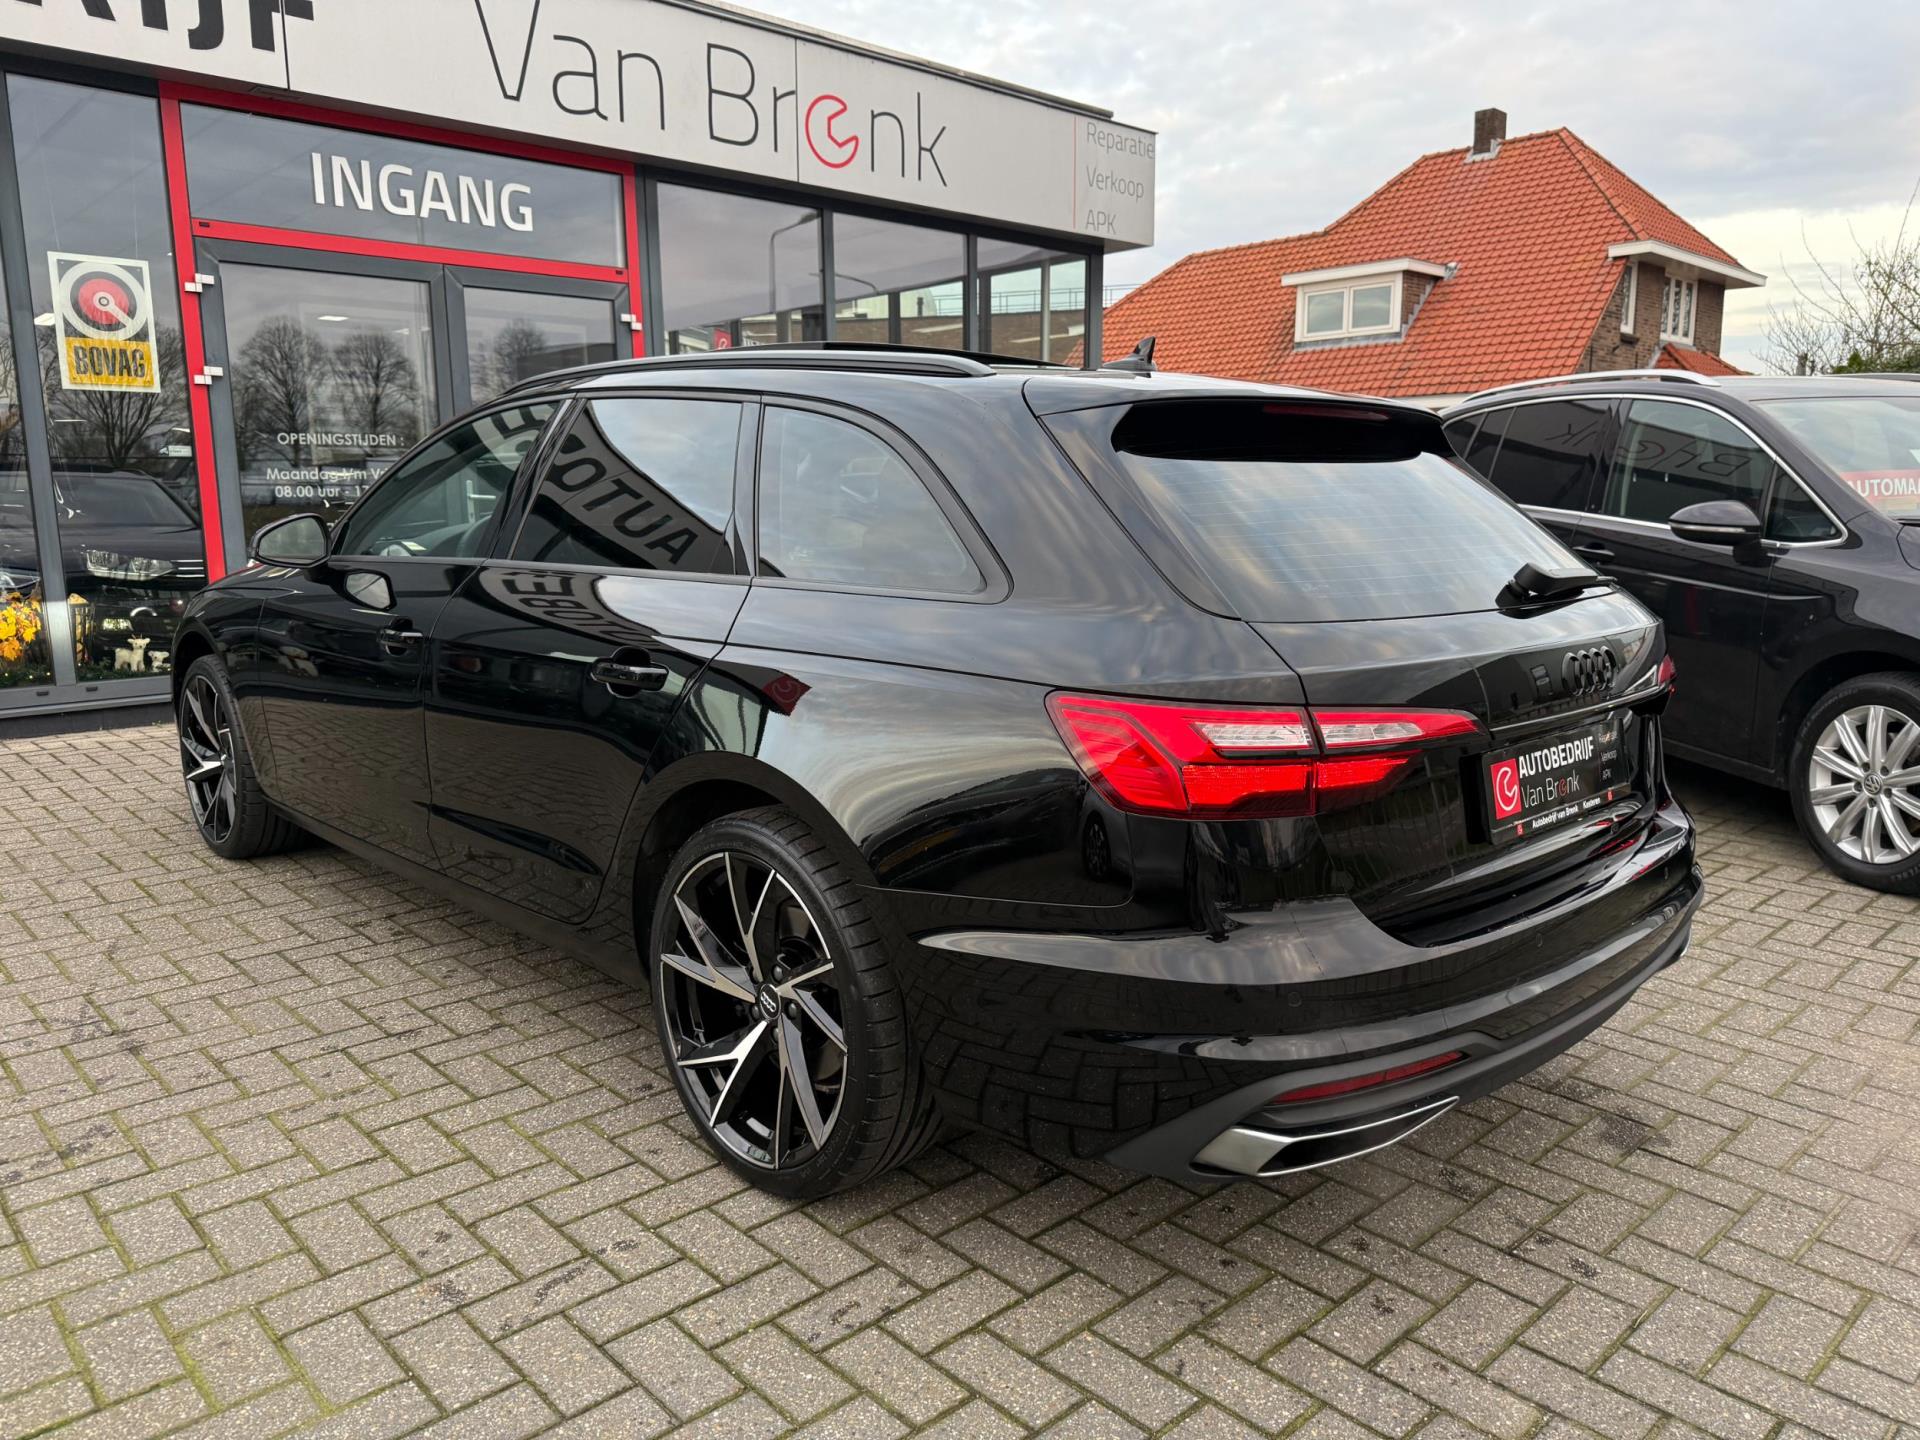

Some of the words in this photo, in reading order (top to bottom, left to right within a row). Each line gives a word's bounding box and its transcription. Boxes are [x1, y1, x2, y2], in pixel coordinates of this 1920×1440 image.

[475, 0, 666, 131] Van
[1086, 121, 1155, 160] Reparatie
[310, 151, 534, 233] INGANG
[1086, 164, 1145, 204] Verkoop
[1085, 209, 1117, 235] APK
[73, 344, 146, 378] BOVAG
[276, 432, 397, 447] OPENINGSTIJDEN
[266, 467, 337, 483] Maandag
[1847, 478, 1920, 497] UTOMA
[275, 485, 314, 498] 08.00
[317, 486, 341, 498] uur
[1518, 736, 1594, 779] AUTOBEDRIJF
[1521, 785, 1545, 808] Van
